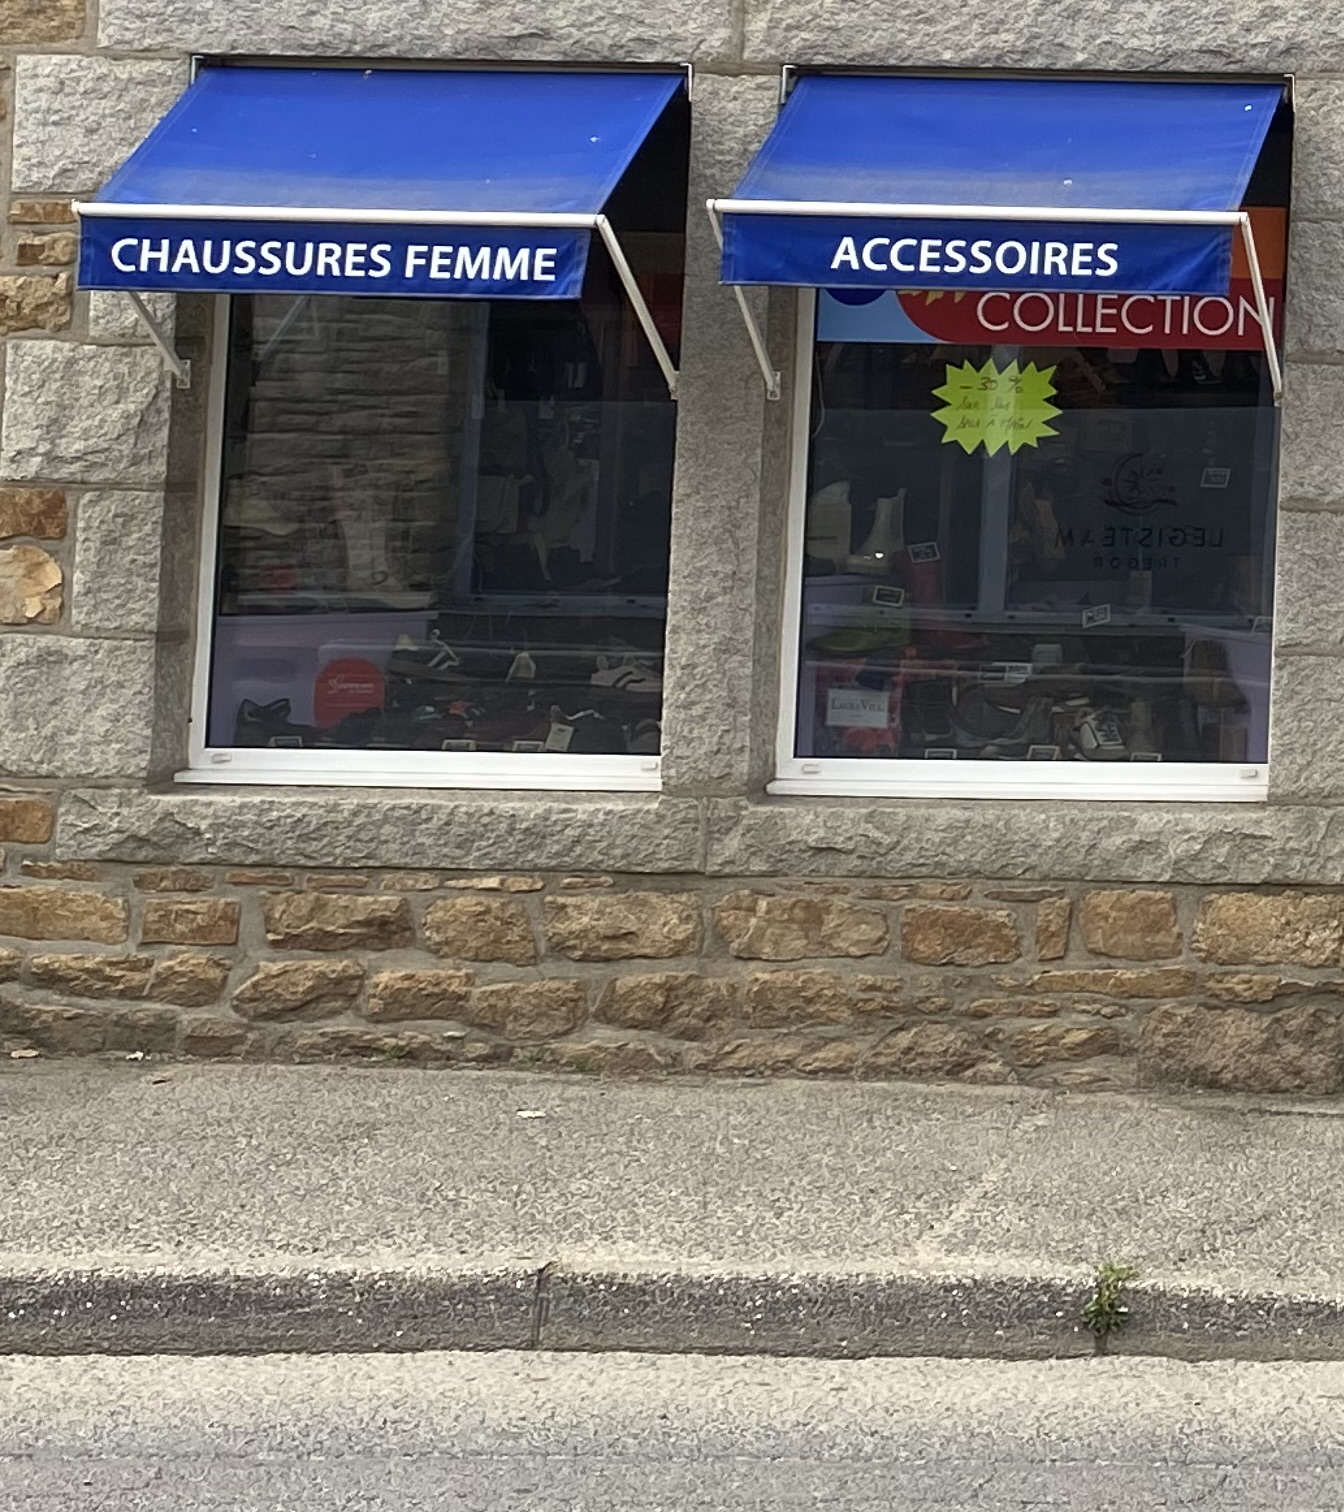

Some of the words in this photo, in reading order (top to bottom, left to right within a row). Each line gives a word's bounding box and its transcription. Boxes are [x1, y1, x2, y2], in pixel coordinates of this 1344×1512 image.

[111, 237, 392, 278] CHAUSSURES
[404, 245, 558, 281] FEMME
[830, 236, 1118, 277] ACCESSOIRES
[976, 291, 1275, 337] COLLECTION
